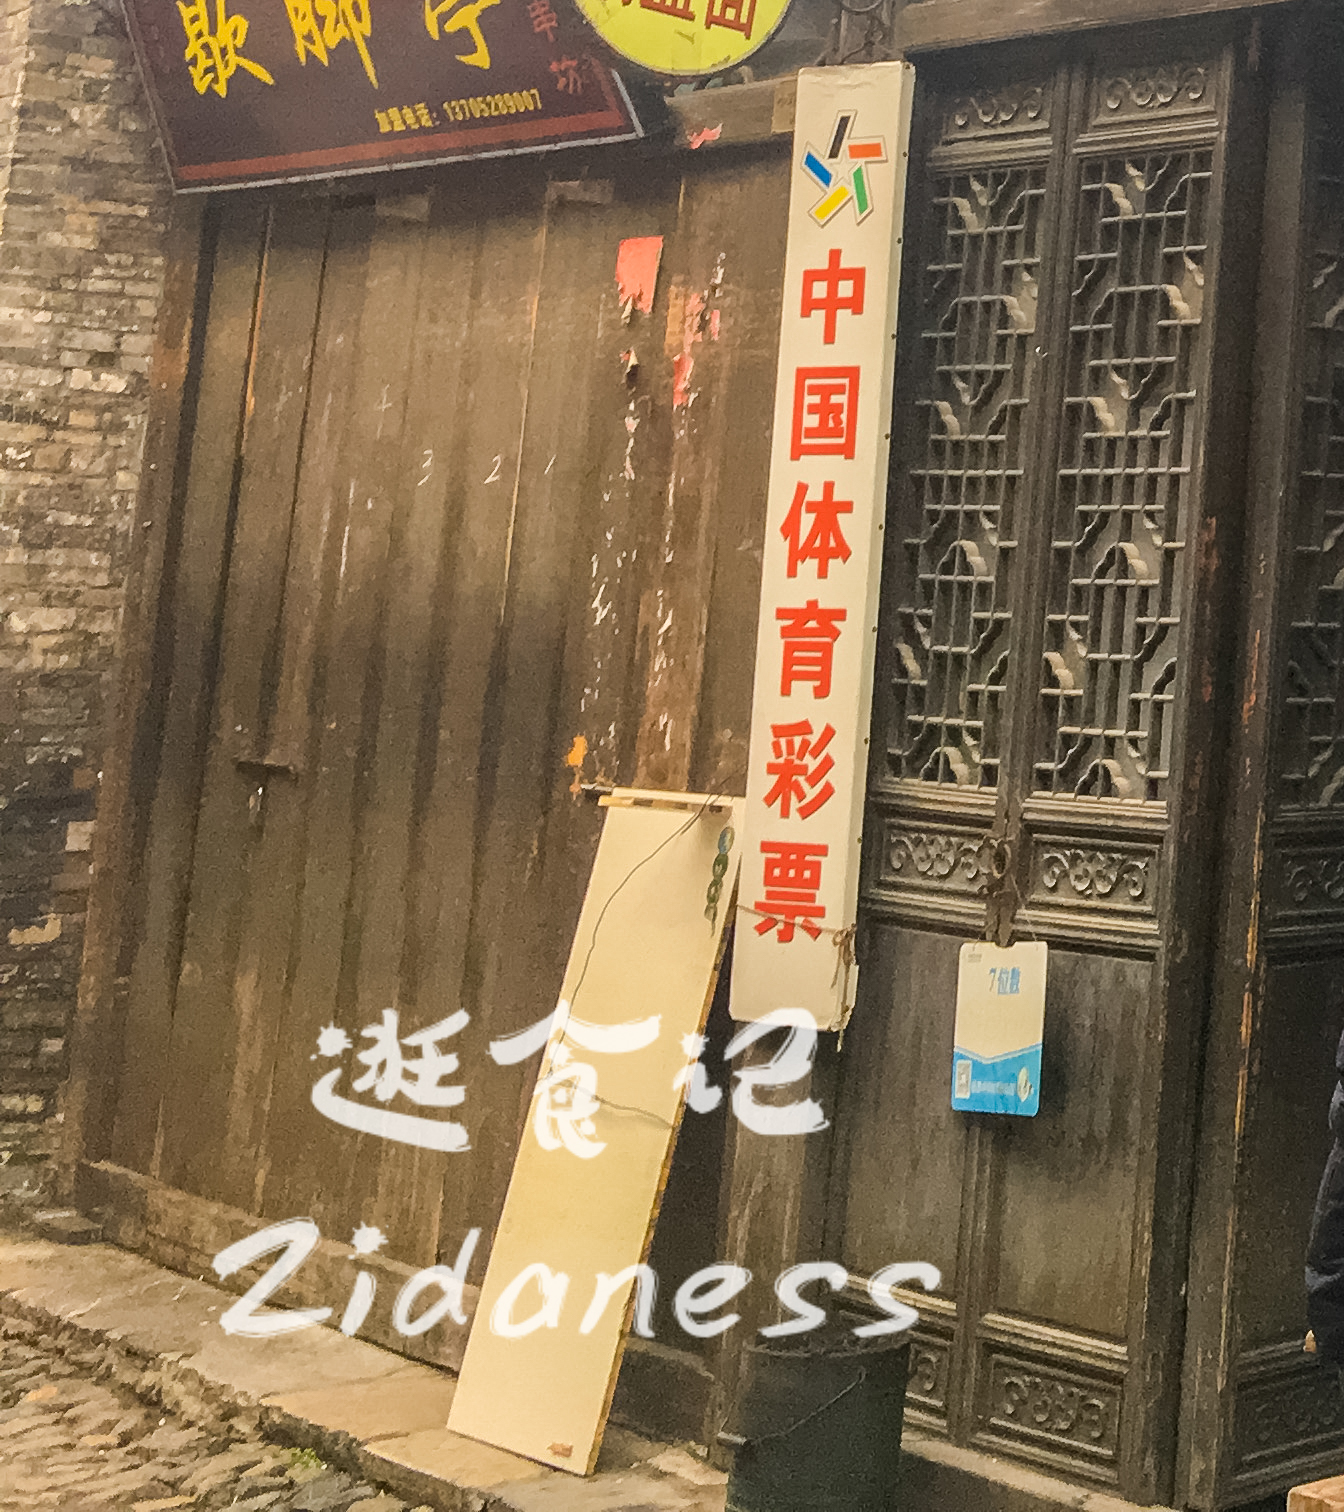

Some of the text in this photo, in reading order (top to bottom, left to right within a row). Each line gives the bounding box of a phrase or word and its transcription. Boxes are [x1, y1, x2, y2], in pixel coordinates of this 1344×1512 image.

[483, 453, 501, 485] 2
[749, 248, 867, 944] 中国体育彩票
